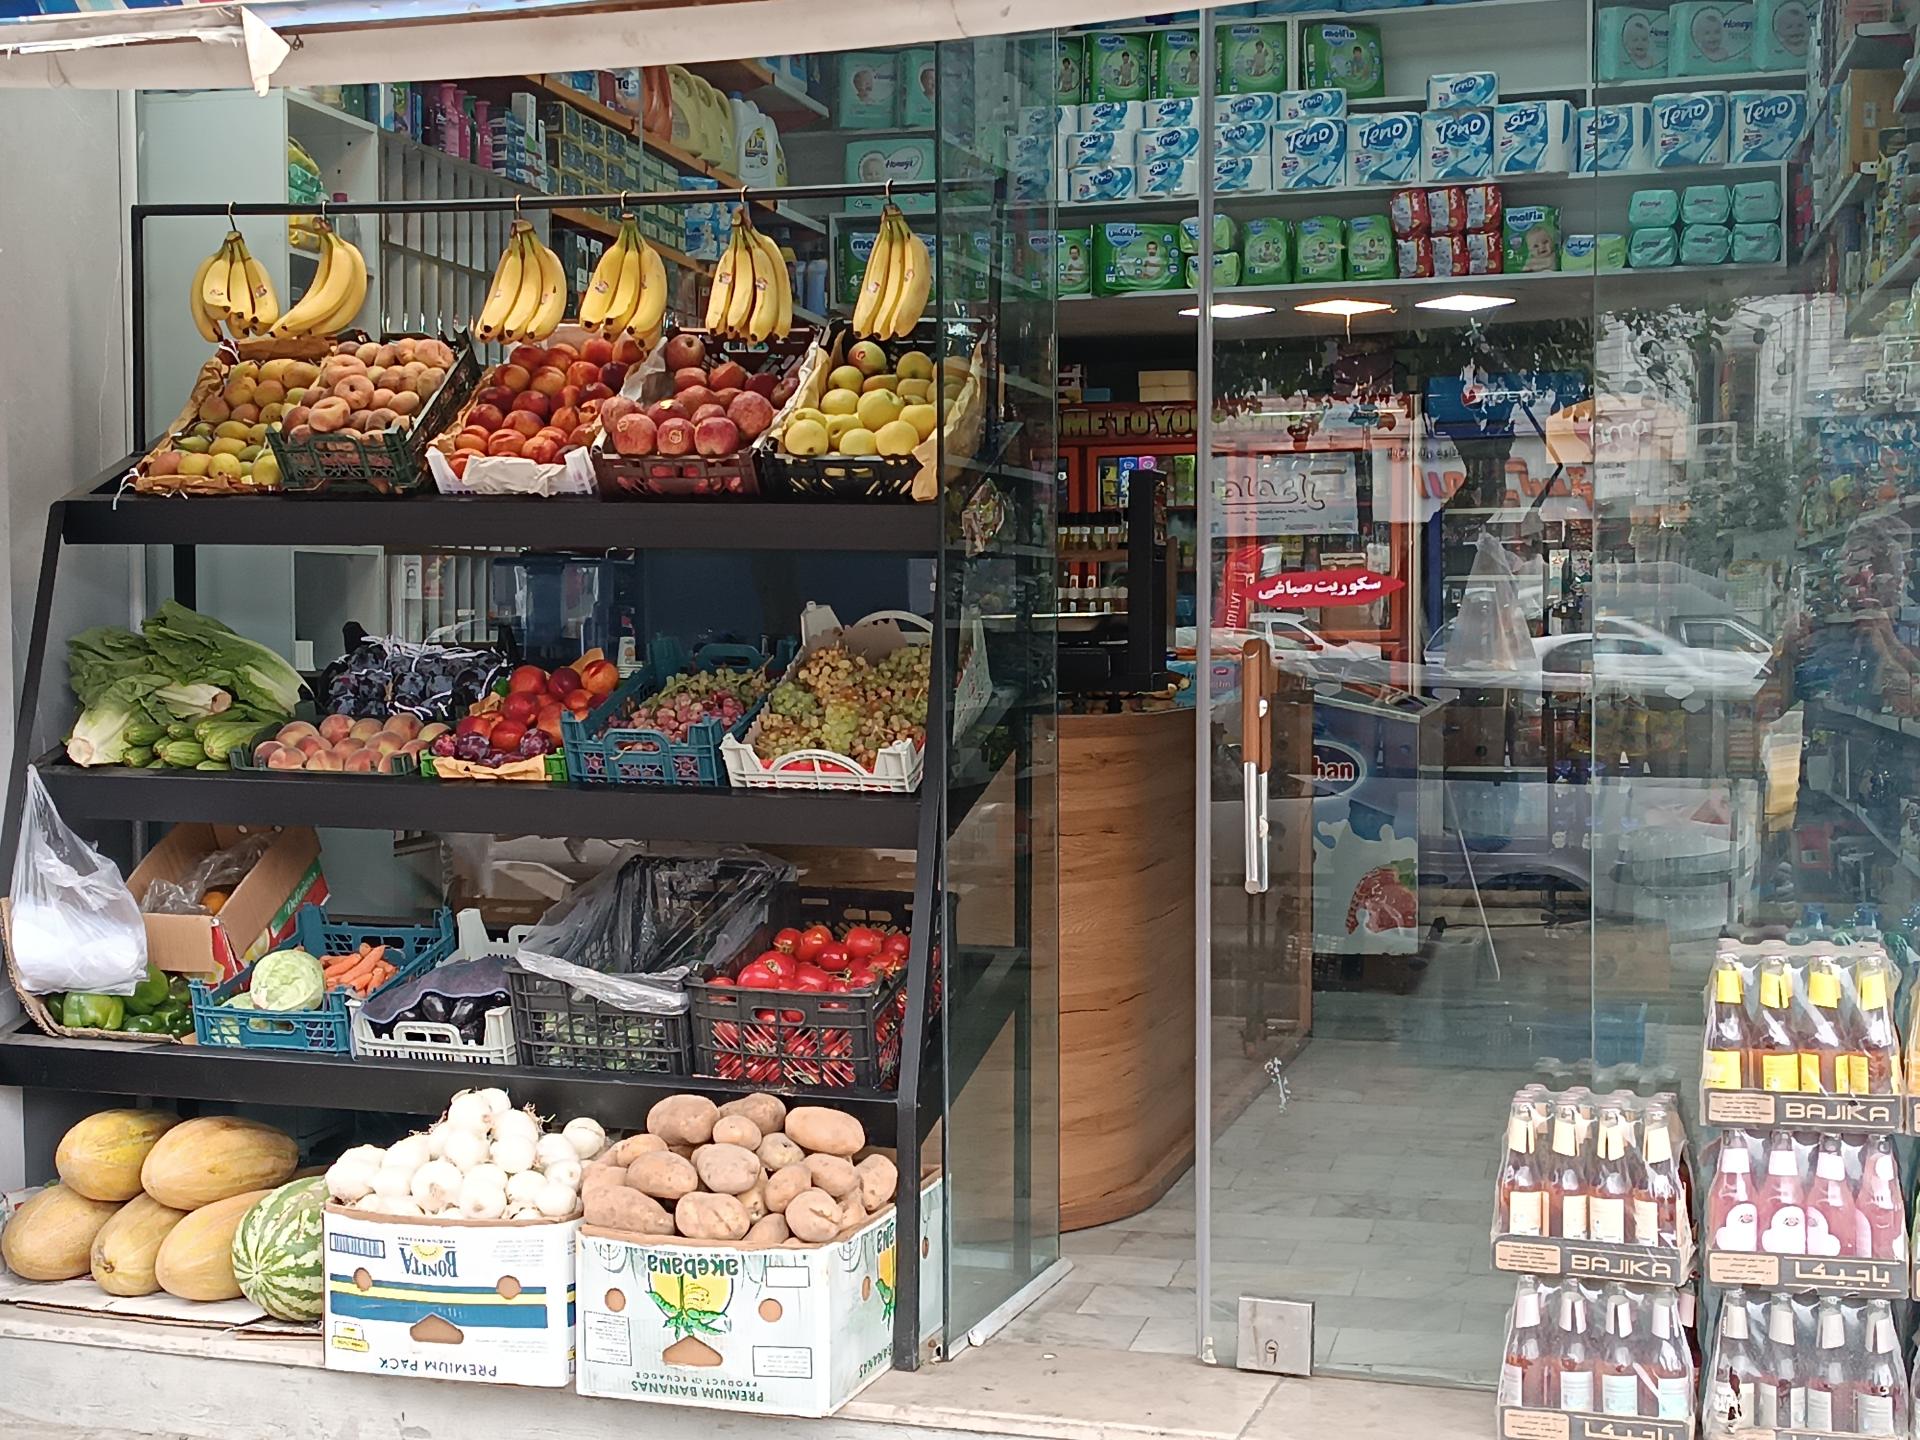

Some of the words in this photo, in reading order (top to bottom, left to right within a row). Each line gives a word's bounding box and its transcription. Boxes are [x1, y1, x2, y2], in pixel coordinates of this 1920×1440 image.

[1451, 77, 1476, 94] Teno
[1661, 103, 1706, 128] Teno
[1745, 100, 1789, 124] Teno
[1287, 128, 1330, 154] Teno
[1361, 122, 1403, 149] Teno
[1437, 118, 1481, 144] Teno
[1507, 211, 1544, 223] molfix
[1114, 411, 1149, 435] TO
[1258, 580, 1313, 600] صباغی
[1315, 576, 1382, 597] سکوریت
[1785, 1102, 1890, 1122] BAJIKA
[399, 1247, 459, 1278] BONITA
[1571, 1254, 1672, 1279] BAJIKA
[1794, 1260, 1891, 1288] باجیکا
[379, 1356, 418, 1371] PACK
[424, 1360, 497, 1377] PREMIUM
[631, 1380, 698, 1397] BANANAS
[701, 1387, 764, 1403] PREMIUM
